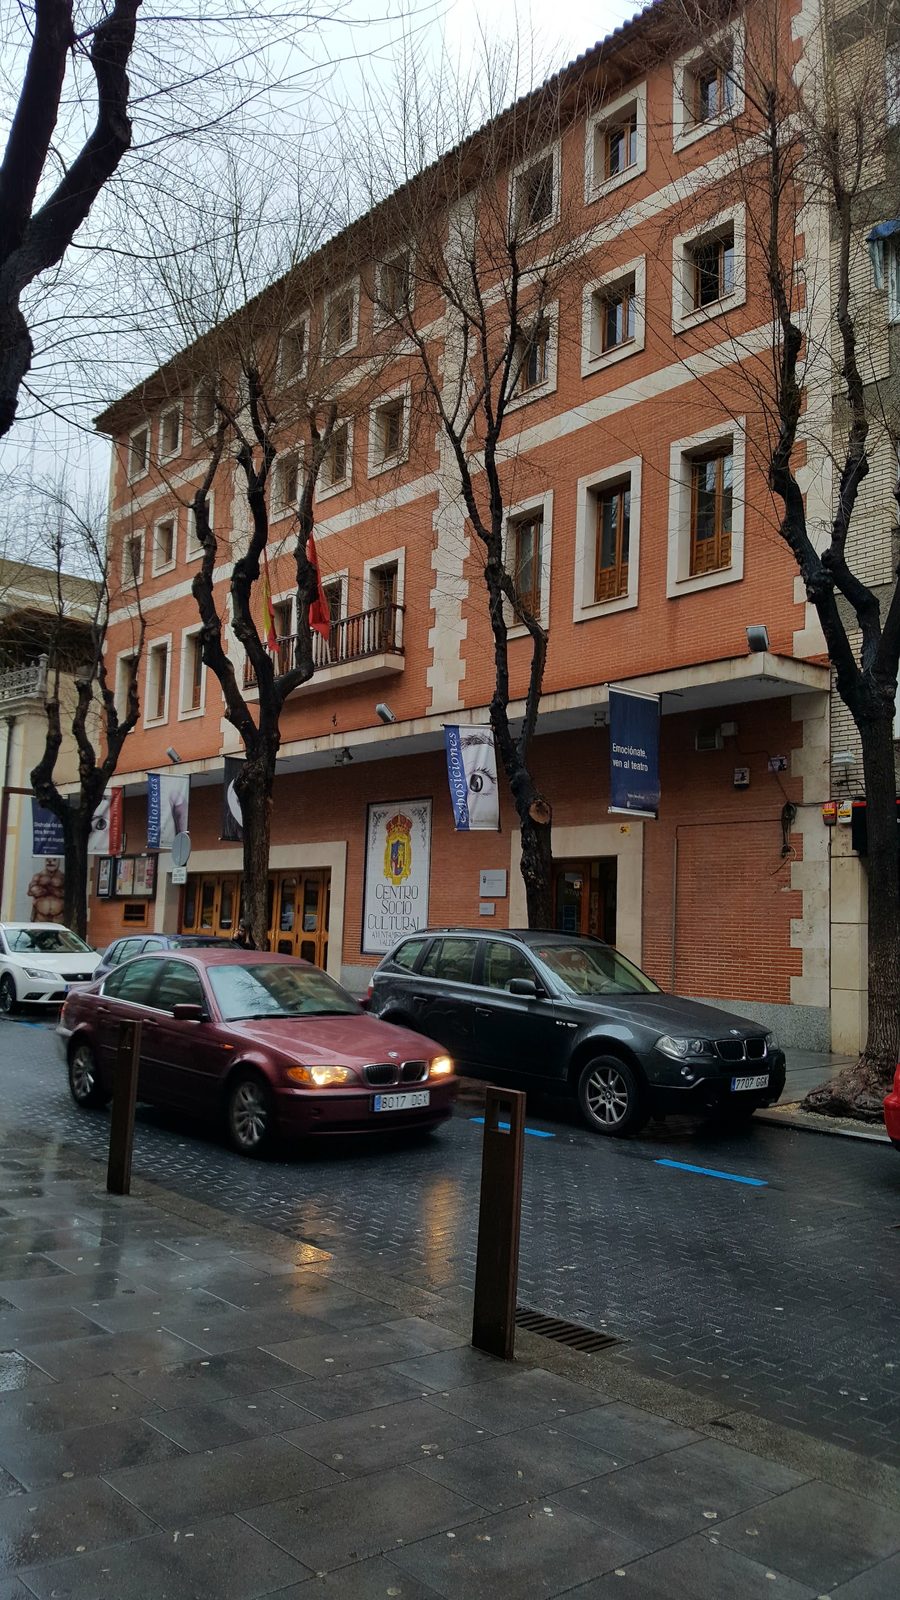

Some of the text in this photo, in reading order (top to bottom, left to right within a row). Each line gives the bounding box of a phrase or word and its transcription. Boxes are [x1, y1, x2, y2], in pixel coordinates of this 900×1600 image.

[612, 743, 648, 760] Emociónate,
[612, 759, 648, 772] ven al teatro
[448, 732, 467, 823] exposiciones
[148, 777, 158, 843] bibliotecas
[375, 883, 419, 900] CENTRO
[381, 900, 412, 915] SOCIO
[736, 1077, 754, 1089] 7707
[381, 1095, 406, 1109] 8017
